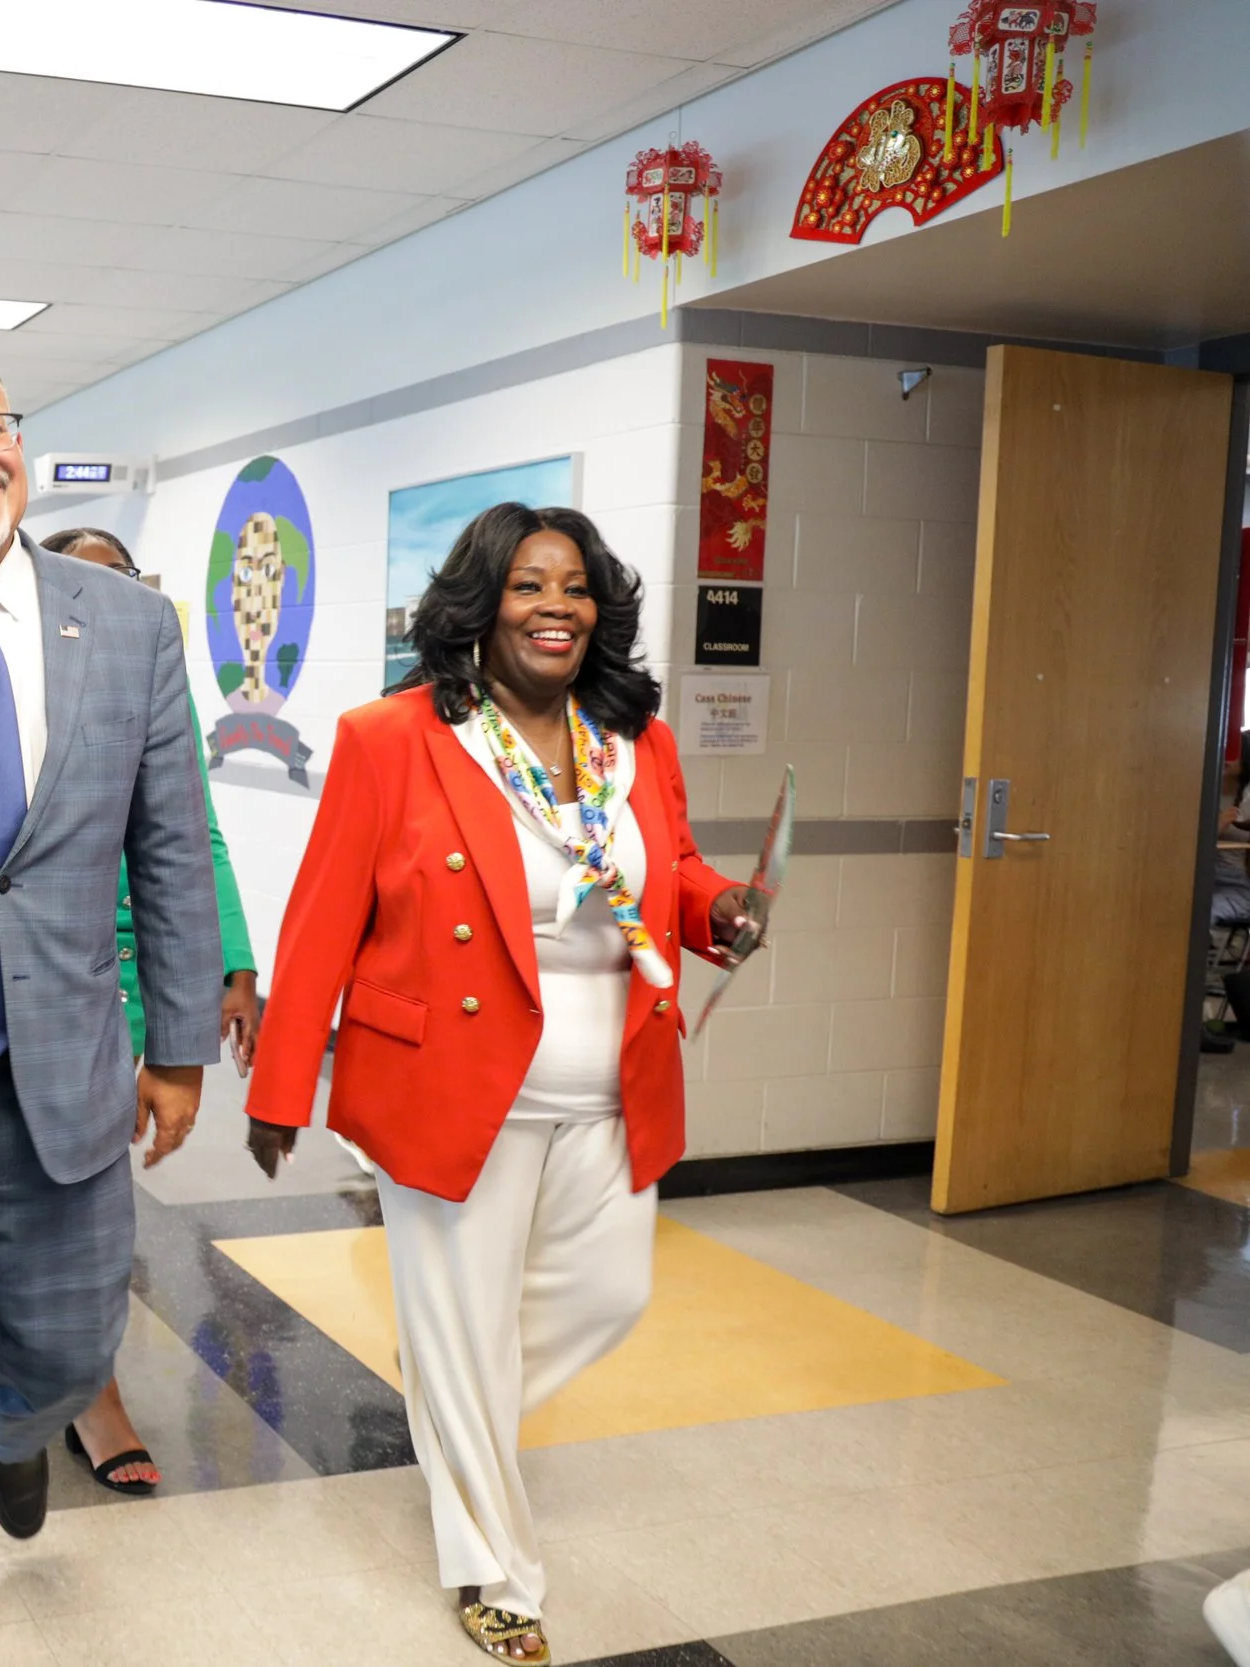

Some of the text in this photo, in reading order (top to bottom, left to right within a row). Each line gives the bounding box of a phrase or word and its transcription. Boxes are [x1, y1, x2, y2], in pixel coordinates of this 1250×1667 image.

[706, 590, 738, 605] 4414
[703, 642, 750, 652] CLASSROOM
[717, 693, 752, 704] Chinese
